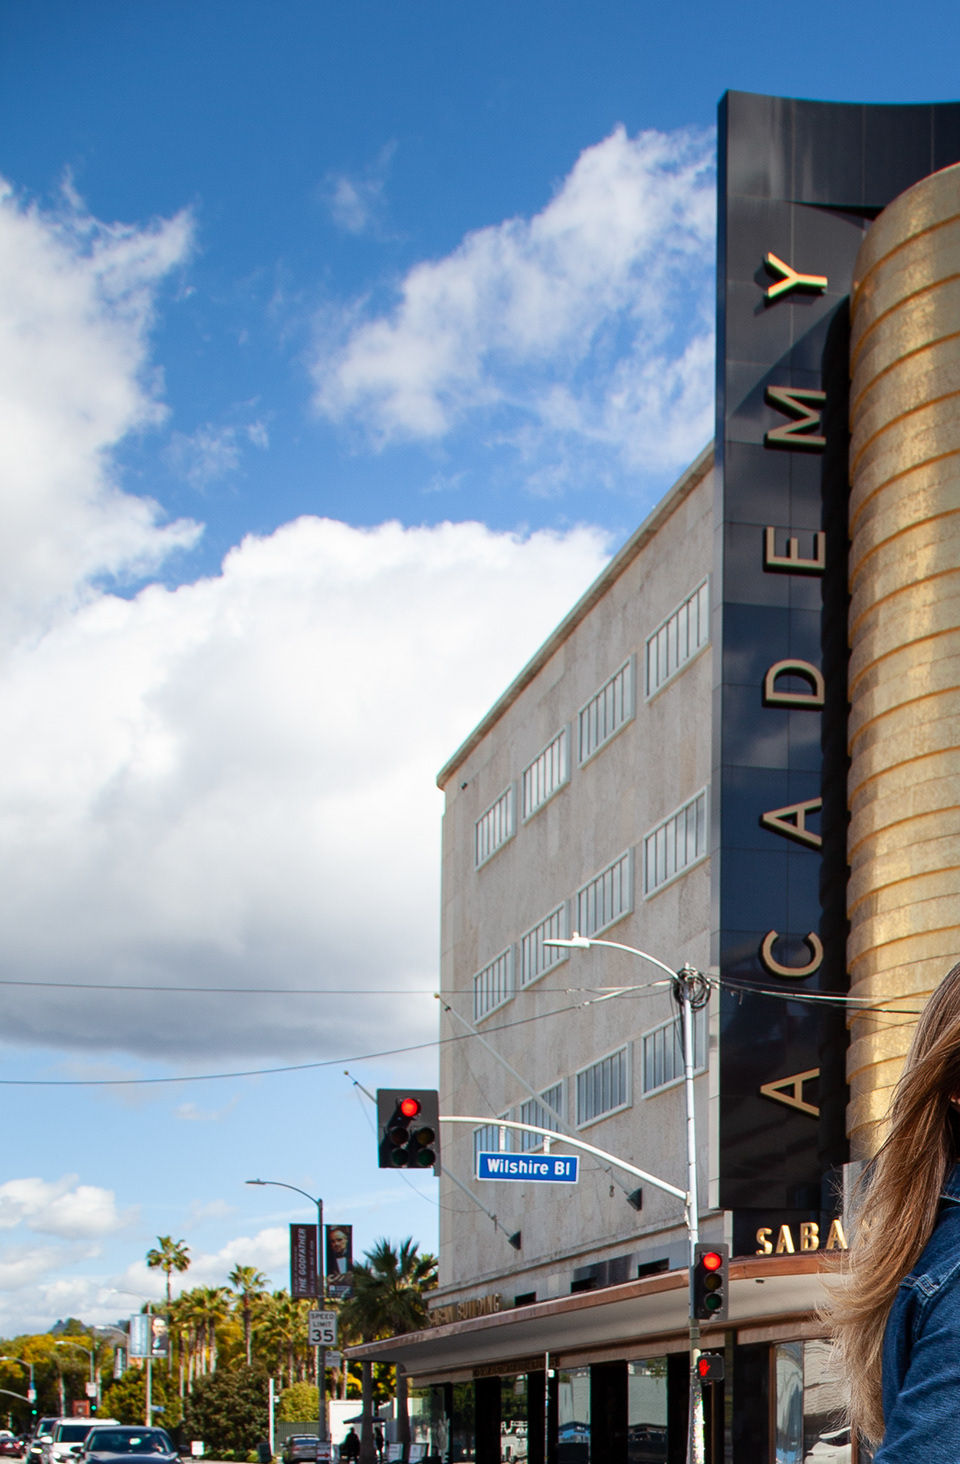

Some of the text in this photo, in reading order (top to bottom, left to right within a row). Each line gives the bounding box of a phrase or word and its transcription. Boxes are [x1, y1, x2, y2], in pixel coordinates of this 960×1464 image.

[759, 251, 828, 1117] ACADEMY
[487, 1158, 570, 1175] Wilshire Bl
[756, 1219, 870, 1255] SABA
[298, 1228, 308, 1293] THE GODFATHER
[311, 1329, 334, 1342] 35
